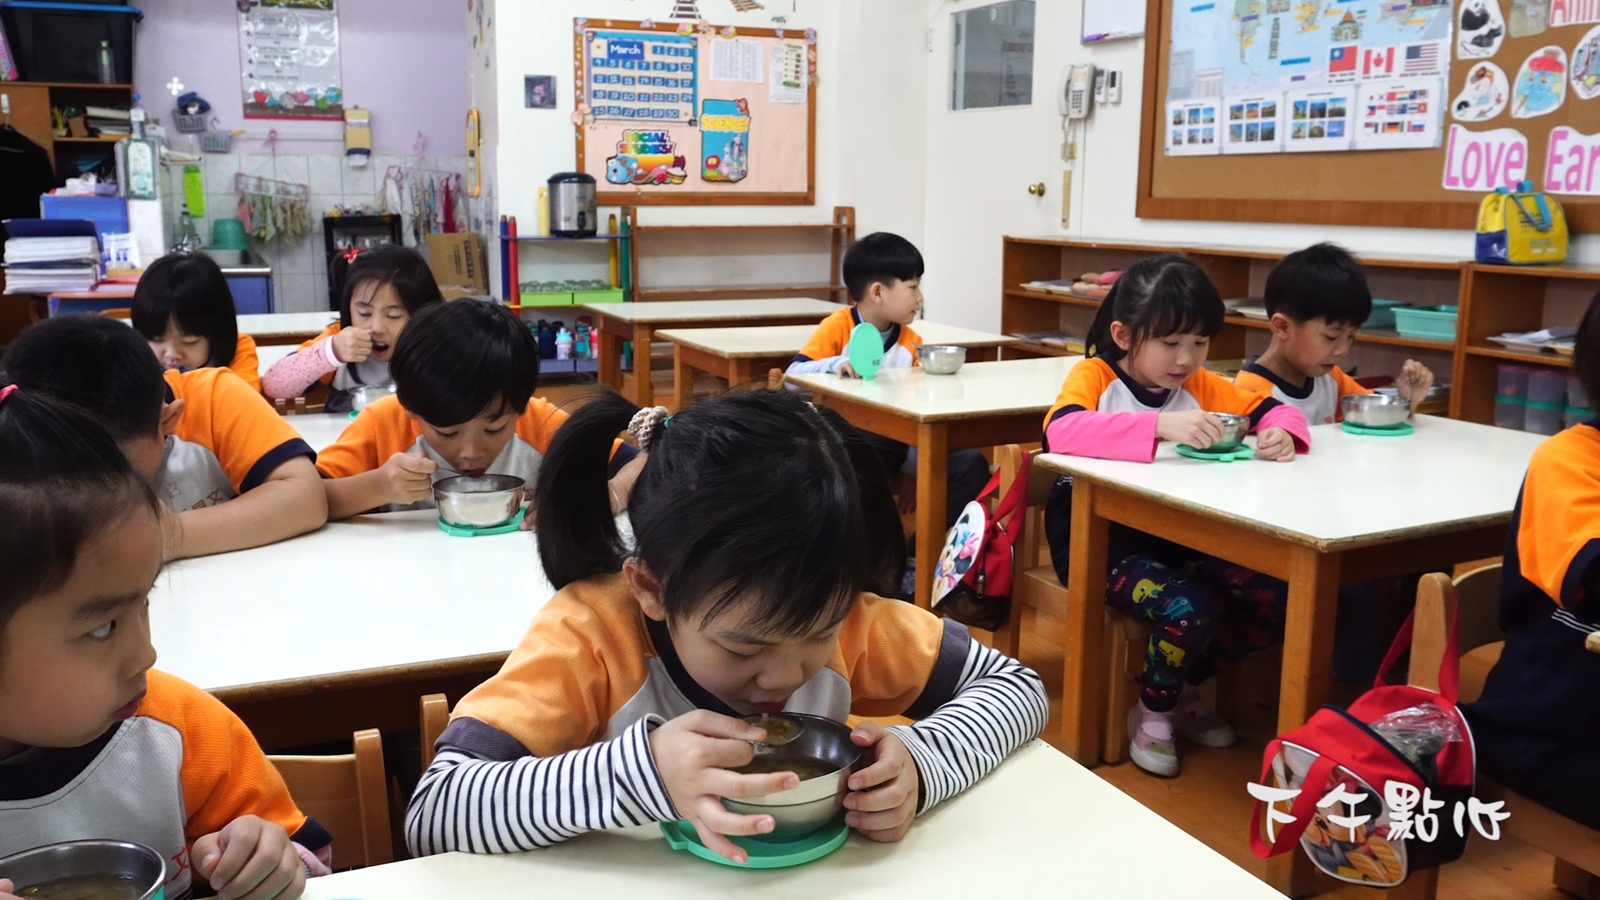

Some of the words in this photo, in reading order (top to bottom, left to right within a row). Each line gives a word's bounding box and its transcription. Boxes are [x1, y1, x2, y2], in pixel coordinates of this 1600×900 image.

[610, 44, 641, 55] March
[669, 63, 676, 71] 9
[655, 78, 663, 86] 15
[625, 131, 668, 143] SOCIAL
[1445, 126, 1526, 189] Love
